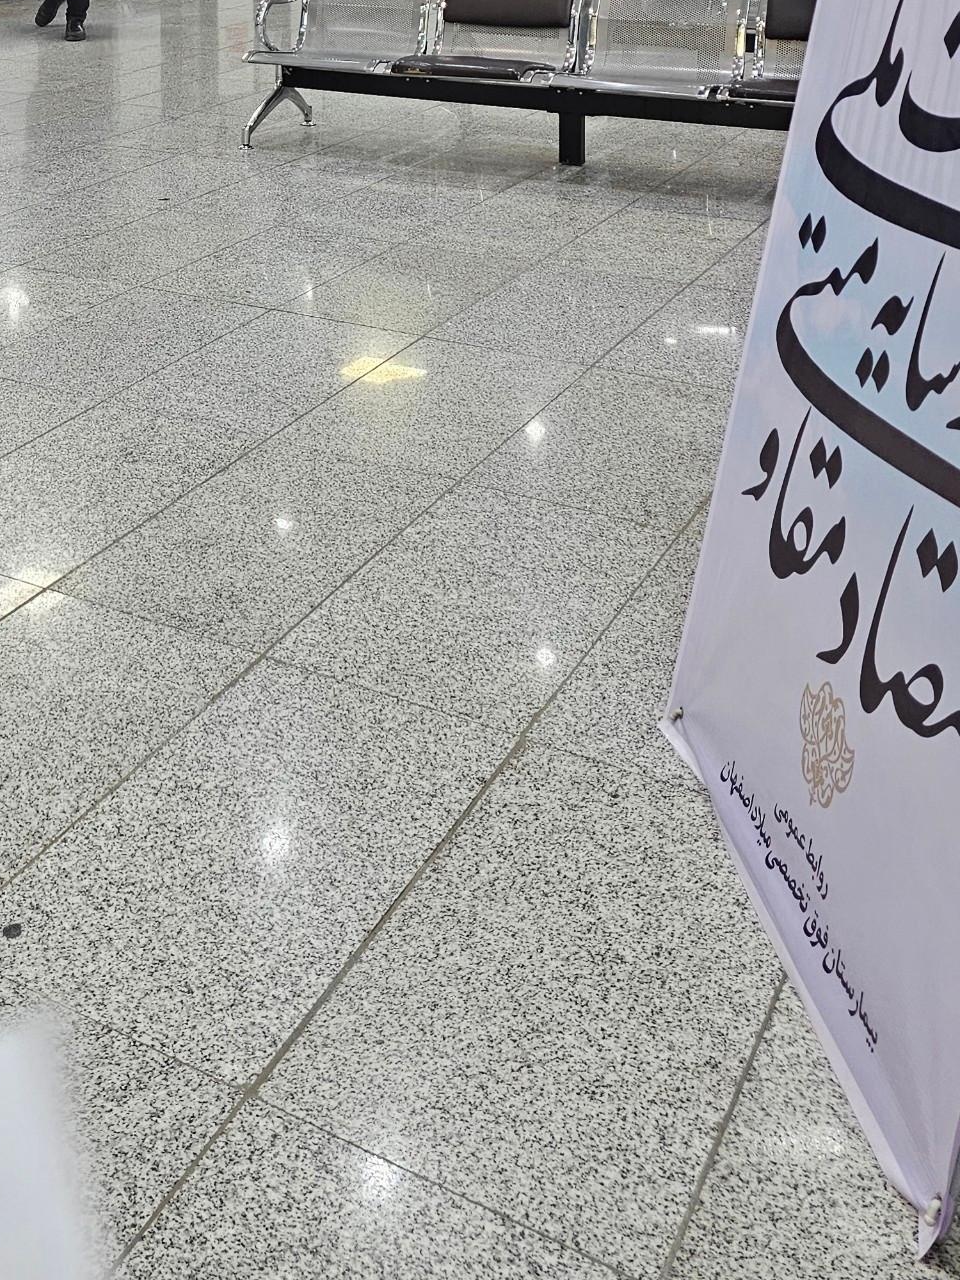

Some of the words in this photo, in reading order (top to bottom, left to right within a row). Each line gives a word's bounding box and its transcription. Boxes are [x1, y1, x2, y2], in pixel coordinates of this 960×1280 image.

[720, 760, 755, 814] اصفهان
[750, 806, 772, 849] میلاد
[764, 850, 811, 913] تخصصی
[802, 910, 830, 949] فوق
[822, 948, 878, 1054] بیمارستان
